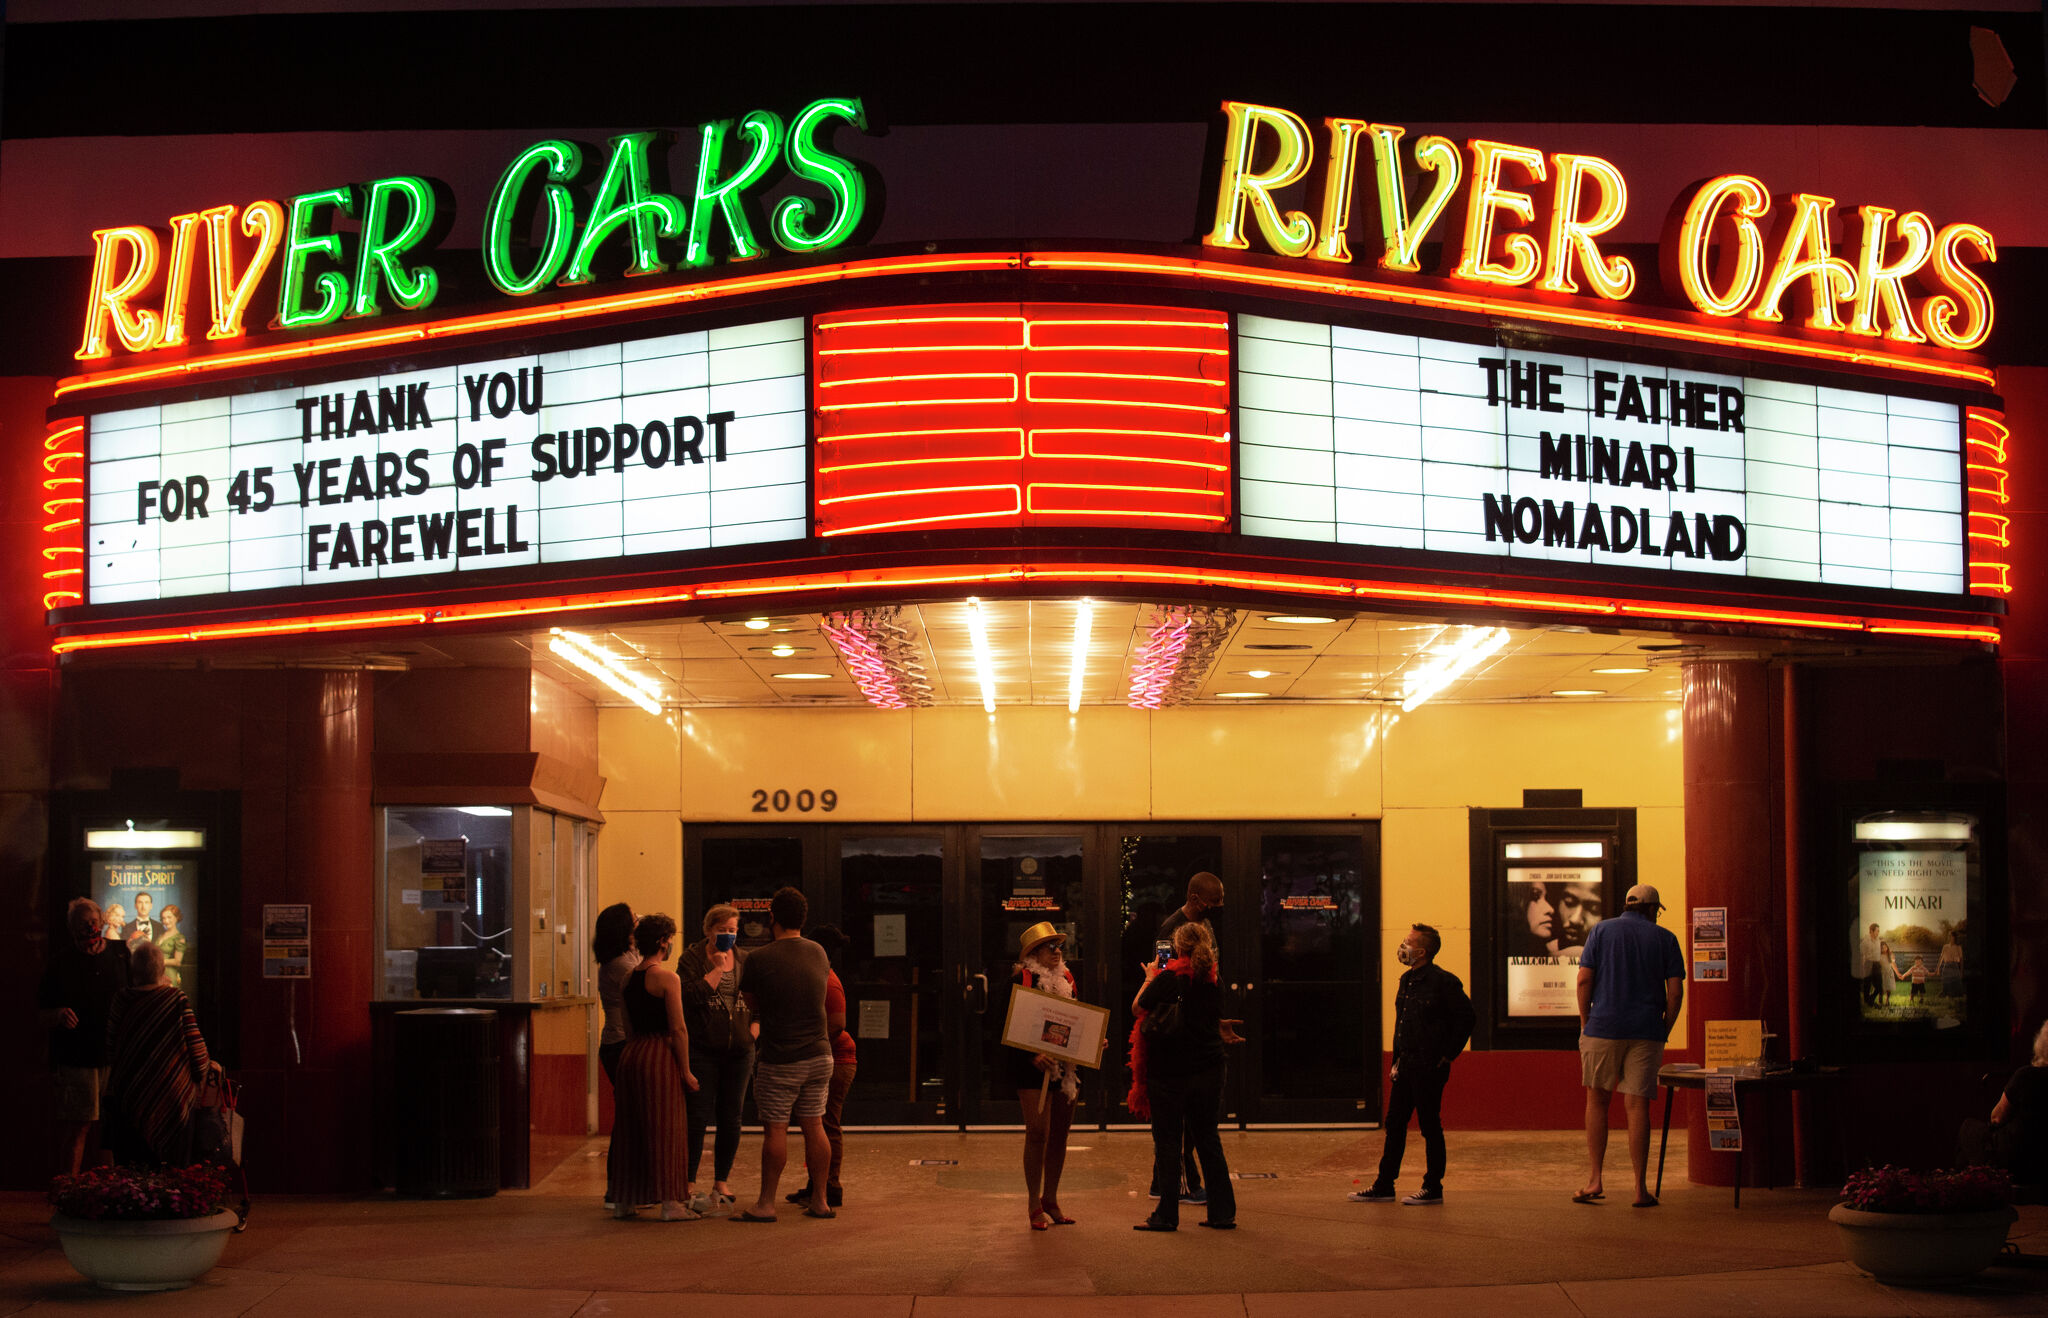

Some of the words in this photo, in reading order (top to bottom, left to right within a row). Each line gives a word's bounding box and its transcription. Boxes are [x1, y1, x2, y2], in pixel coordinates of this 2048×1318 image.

[75, 176, 438, 360] RIVER
[482, 97, 868, 296] OAKS
[1202, 101, 1636, 300] RIVER
[1679, 174, 1997, 350] OAKS
[296, 382, 432, 443] THANK
[464, 366, 543, 421] YOU
[1478, 358, 1564, 413] THE
[1594, 370, 1745, 433] FATHER
[138, 475, 209, 525] FOR
[227, 466, 274, 514] 45
[293, 449, 430, 507] YEARS
[453, 438, 506, 489] OF
[532, 411, 735, 482] SUPPORT
[1540, 431, 1695, 493] MINARI
[308, 505, 528, 571] FAREWELL
[1483, 493, 1746, 561] NOMADLAND
[752, 789, 838, 812] 2009
[109, 870, 143, 886] BLITHE
[145, 870, 175, 887] SPIRIT
[1882, 869, 1904, 877] NEED
[1907, 869, 1932, 877] RIGHT
[1898, 859, 1906, 867] IS
[1909, 859, 1923, 867] THE
[1884, 895, 1942, 910] MINARI
[1511, 956, 1560, 966] MALCOLM
